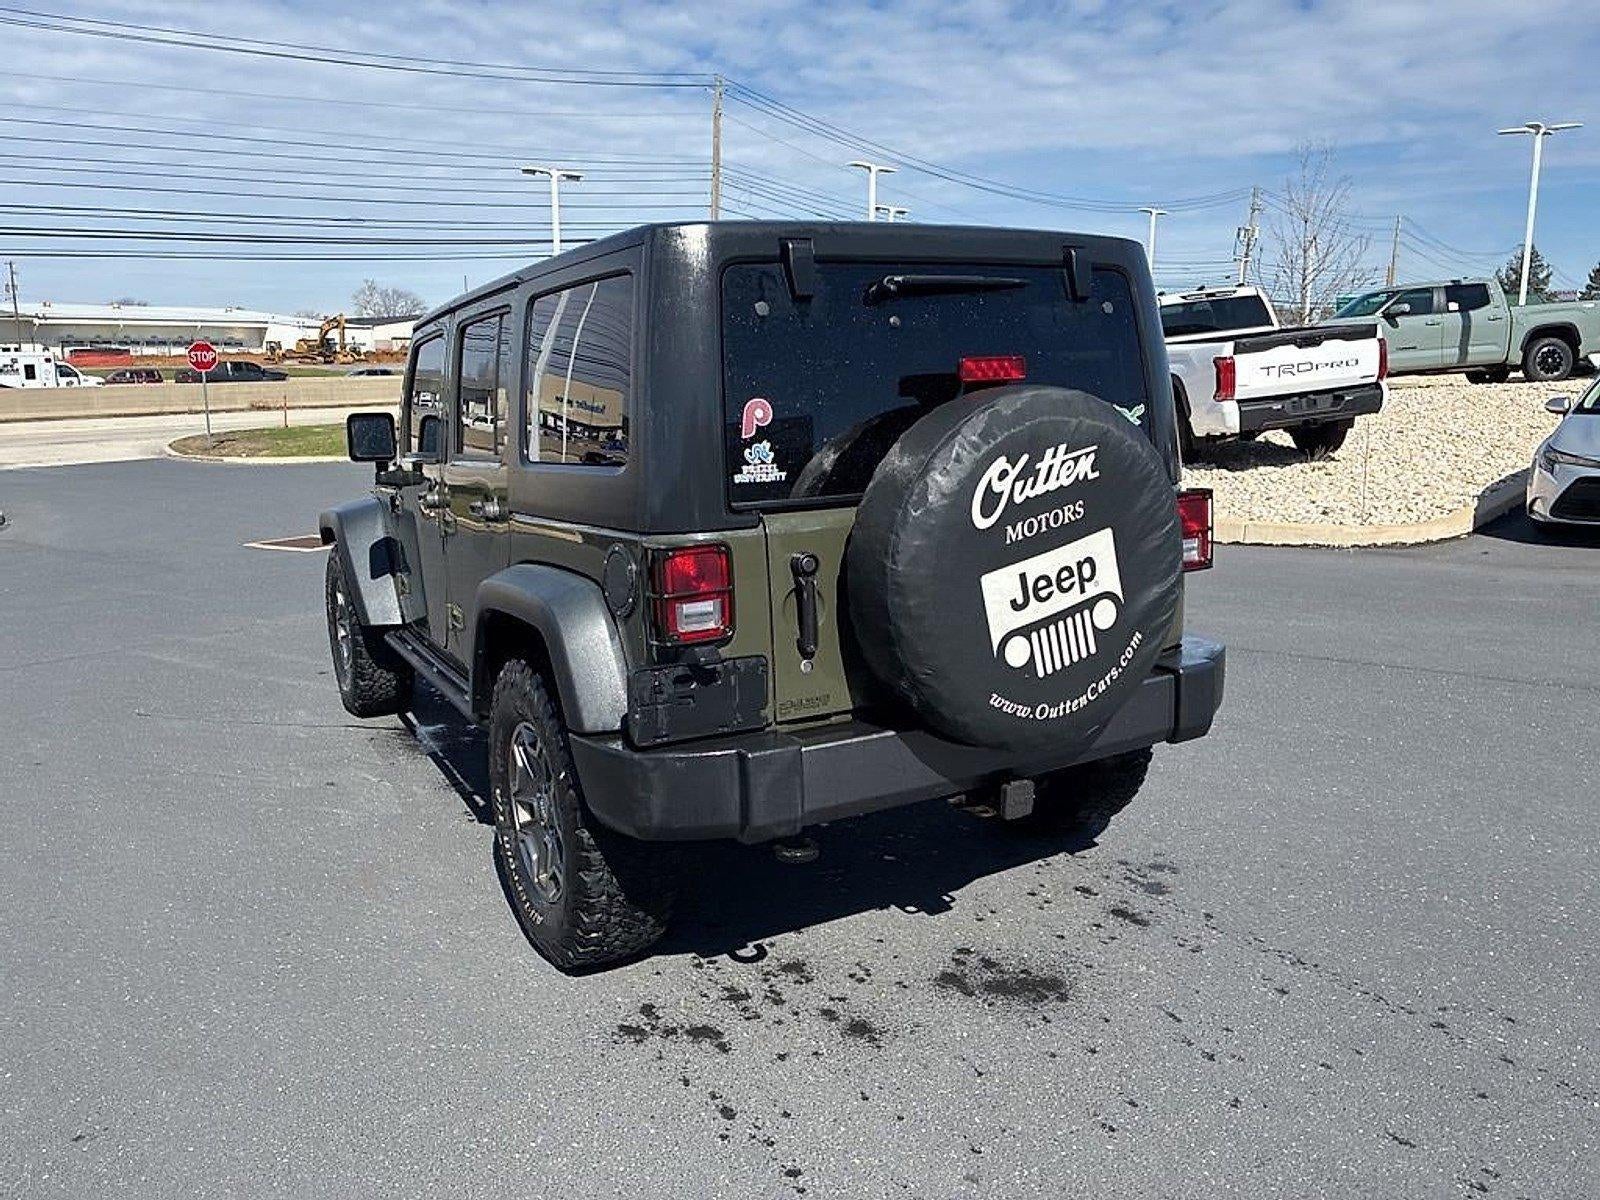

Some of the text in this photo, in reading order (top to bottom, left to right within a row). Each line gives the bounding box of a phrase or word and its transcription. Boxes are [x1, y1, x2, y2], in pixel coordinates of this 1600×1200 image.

[190, 350, 216, 363] STOP
[971, 443, 1101, 530] Outten
[1004, 500, 1086, 545] MOTORS
[1009, 555, 1097, 613] Jeep
[988, 630, 1144, 721] www.OuttenCars.com
